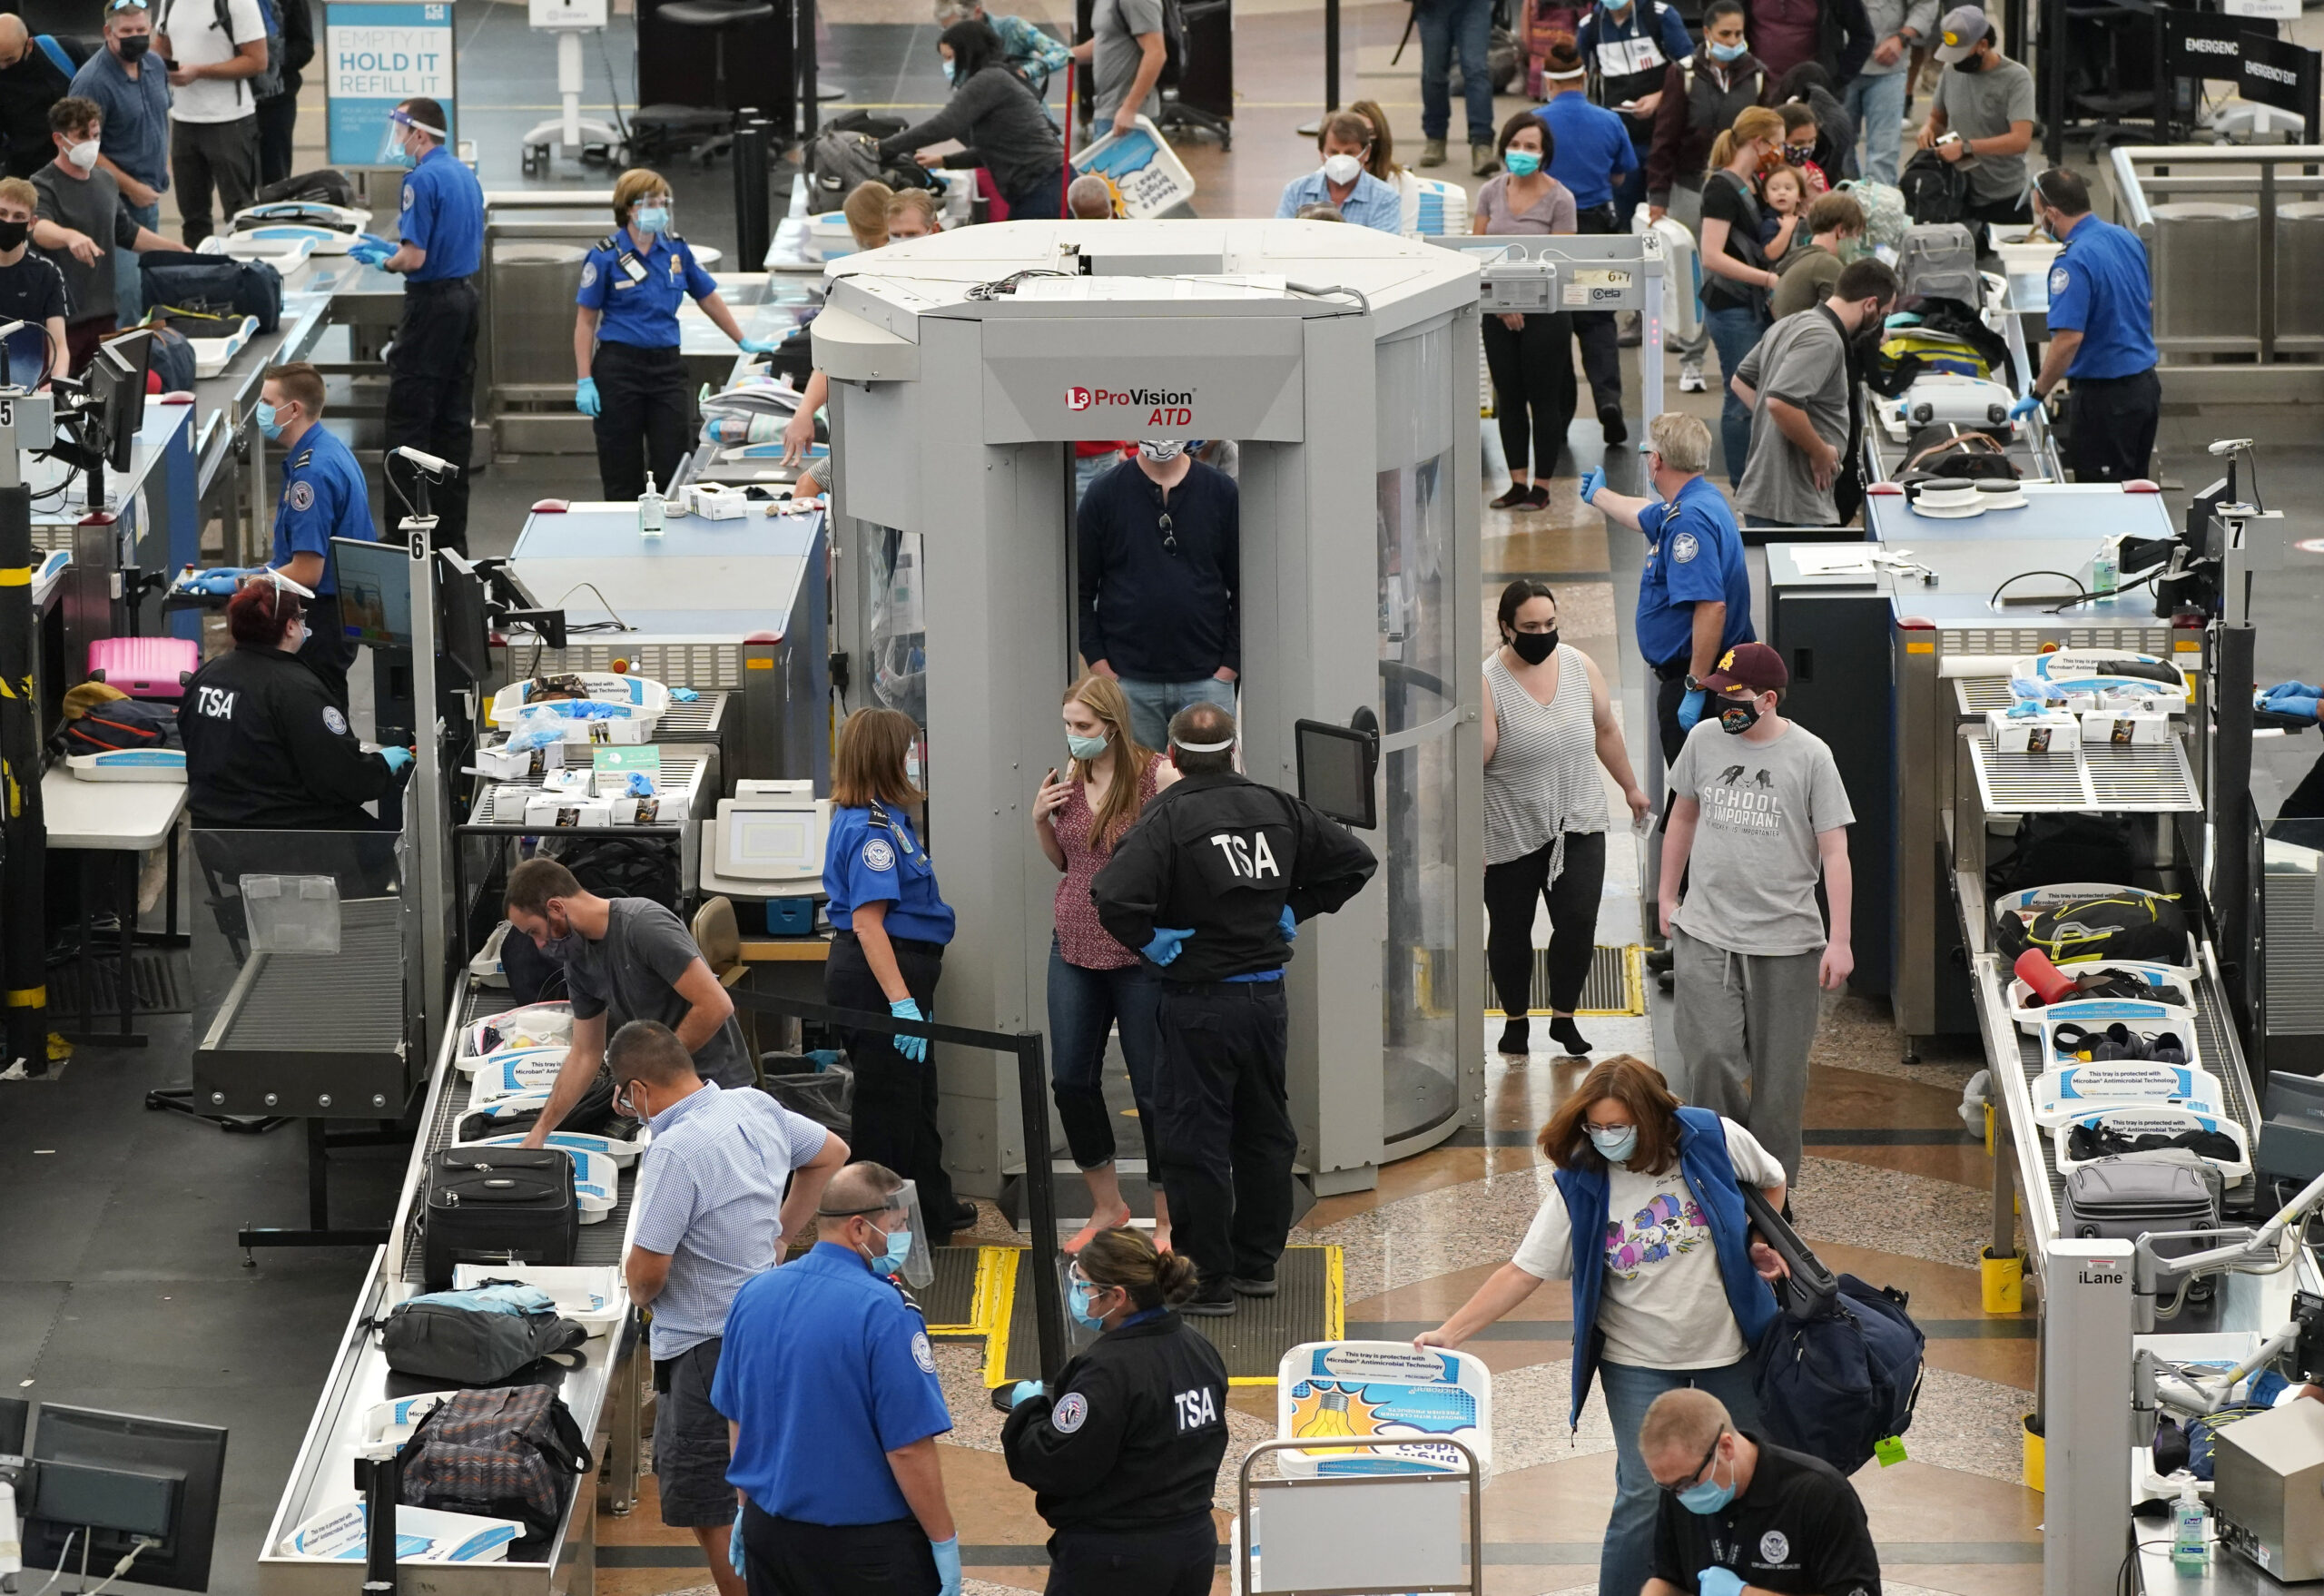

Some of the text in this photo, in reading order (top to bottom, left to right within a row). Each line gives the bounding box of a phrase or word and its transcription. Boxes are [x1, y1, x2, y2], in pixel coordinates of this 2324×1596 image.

[339, 31, 438, 49] EMPTY IT
[2185, 37, 2240, 55] EMERGENC
[340, 53, 439, 72] HOLD IT
[2244, 60, 2298, 86] EMERGENCY EXIT
[340, 75, 440, 94] REFILL IT
[1150, 182, 1178, 206] Need
[1, 401, 11, 426] 5
[1147, 409, 1192, 426] ATD
[411, 533, 424, 560] 6
[2230, 522, 2243, 548] 7
[198, 686, 234, 720] TSA
[2070, 740, 2075, 748] S
[1704, 786, 1781, 814] SCHOOL
[1714, 805, 1782, 828] IMPORTANT
[1742, 827, 1779, 837] IMPORTANTER
[1210, 832, 1280, 879] TSA
[1175, 1387, 1216, 1430] TSA
